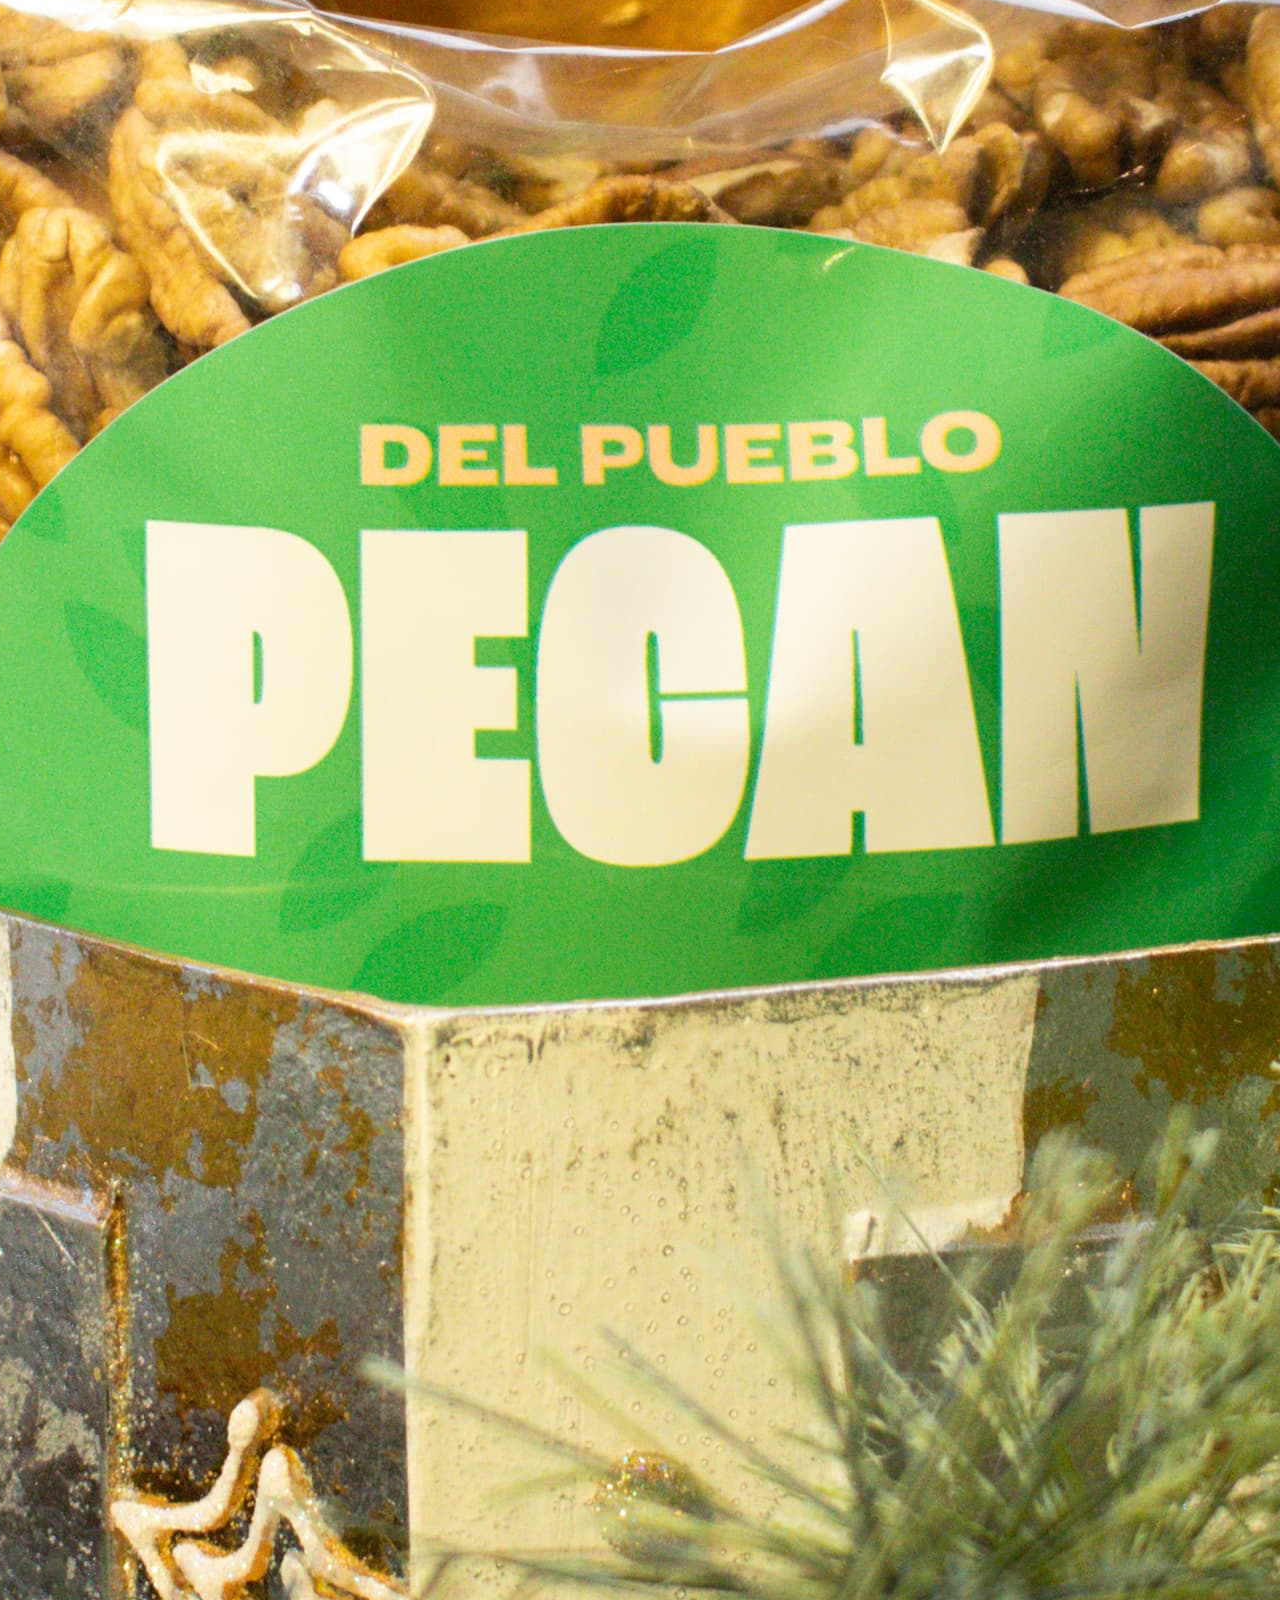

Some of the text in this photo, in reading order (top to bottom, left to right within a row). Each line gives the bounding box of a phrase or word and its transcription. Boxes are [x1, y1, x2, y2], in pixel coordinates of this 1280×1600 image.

[358, 409, 1003, 487] DEL PUEBLO
[145, 501, 1216, 868] PECAN
